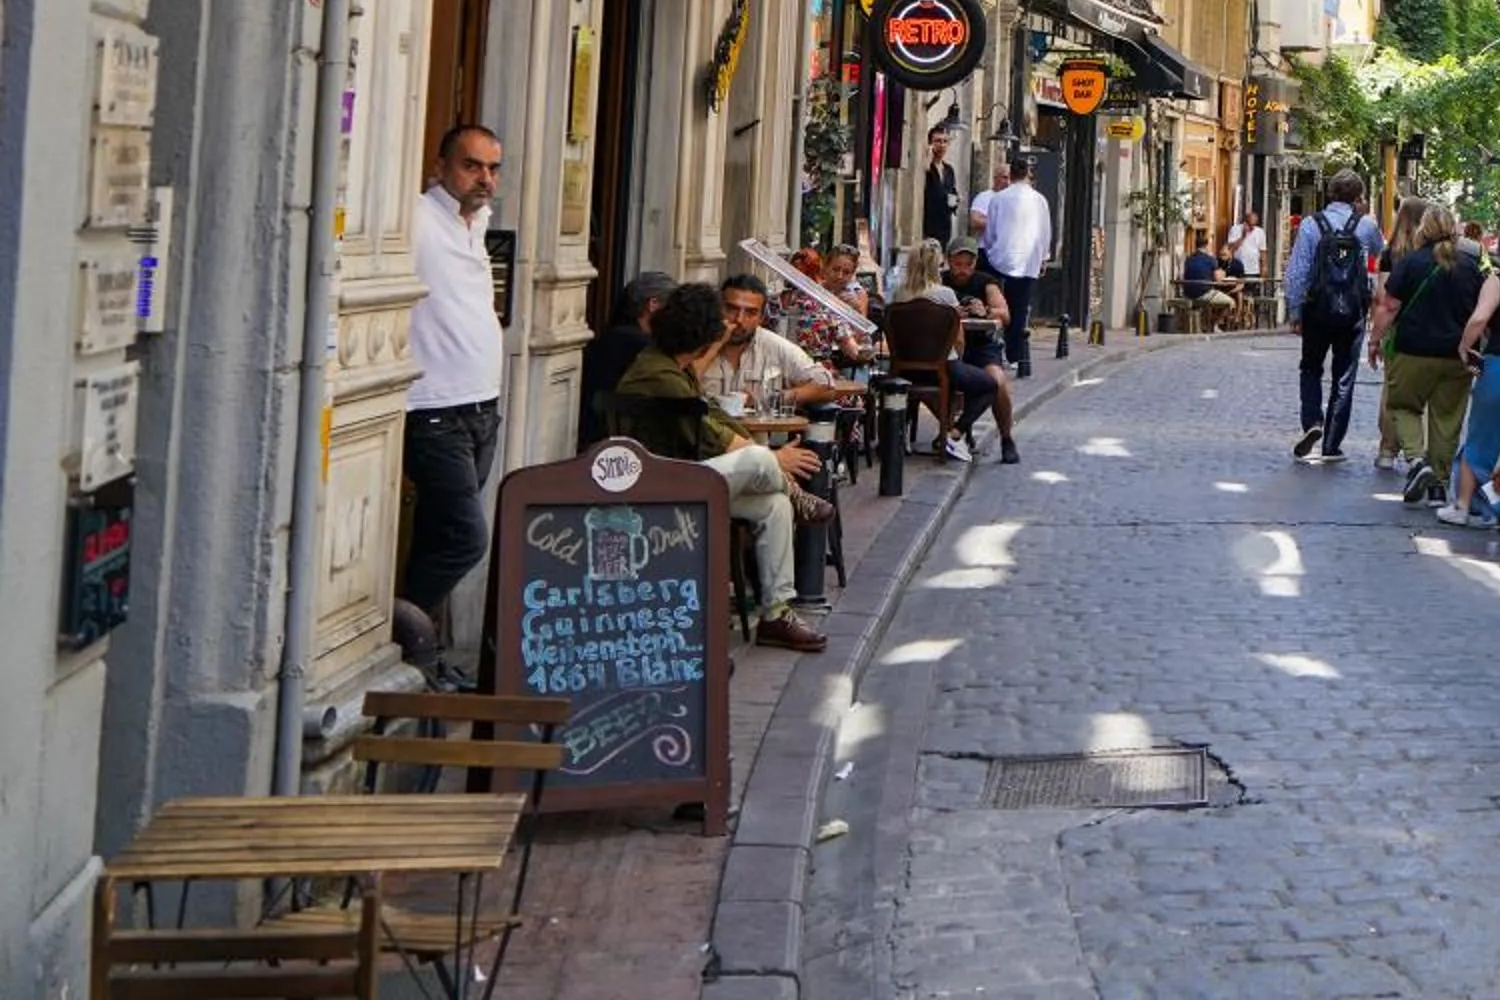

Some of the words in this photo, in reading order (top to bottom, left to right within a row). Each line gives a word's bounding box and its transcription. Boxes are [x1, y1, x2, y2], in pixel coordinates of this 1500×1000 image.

[888, 17, 965, 46] RETRO
[1246, 83, 1259, 143] HOTEL
[526, 512, 584, 566] Cold
[649, 506, 699, 555] Draft
[523, 574, 700, 611] Carlsberg
[521, 605, 694, 640] Guinness
[527, 660, 606, 694] 1664
[615, 655, 704, 690] Blanc
